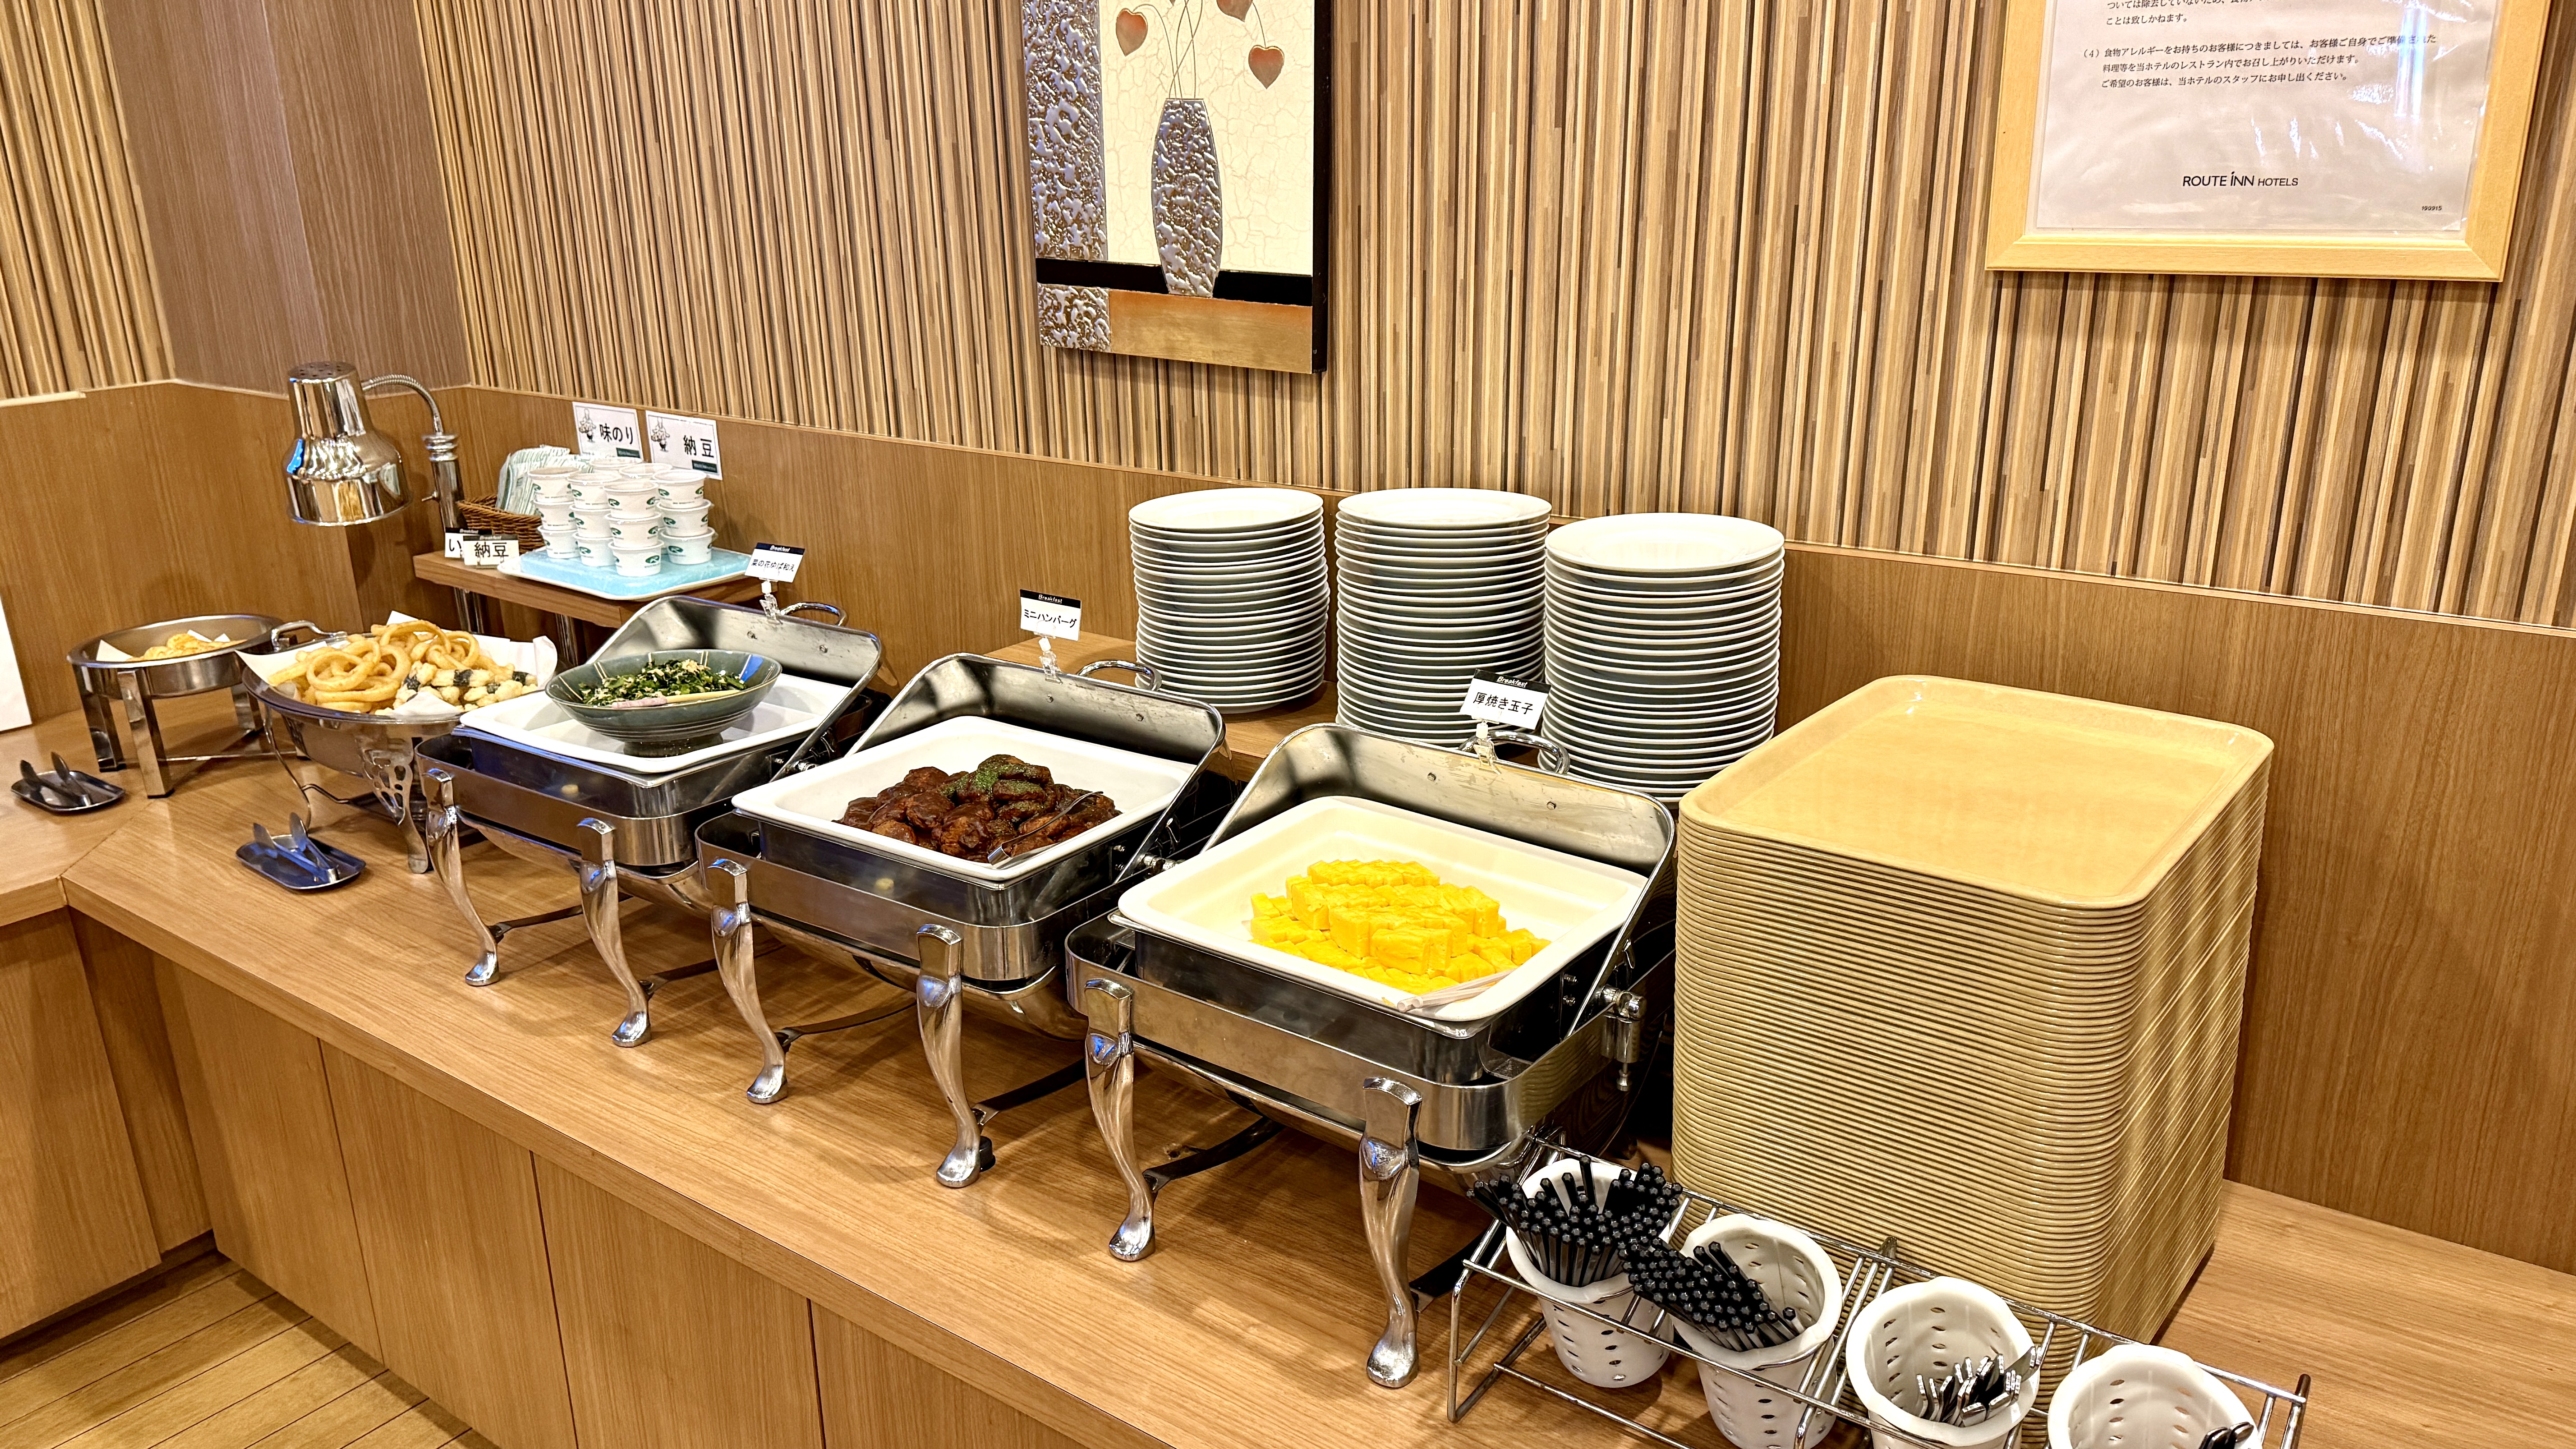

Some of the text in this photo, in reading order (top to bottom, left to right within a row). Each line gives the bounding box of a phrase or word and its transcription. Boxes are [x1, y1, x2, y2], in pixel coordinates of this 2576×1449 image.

[2107, 13, 2187, 25] ことは致しかねます。
[2103, 54, 2359, 73] 料理等を当ホテルのレストラン内でお召し上がりいただけます。
[2102, 71, 2347, 88] ご希望のお客様は、当ホテルのスタッフにお申し出ください。
[2183, 175, 2227, 186] ROUTE
[2258, 178, 2298, 186] HOTELS
[599, 423, 633, 444] 味のり
[683, 435, 714, 458] 納豆
[474, 542, 509, 557] 納豆
[1039, 594, 1062, 604] Breakfast
[1024, 609, 1077, 628] ミニハンバーグ
[1496, 676, 1528, 688] Breakfast
[1473, 692, 1533, 714] 厚焼き玉子
